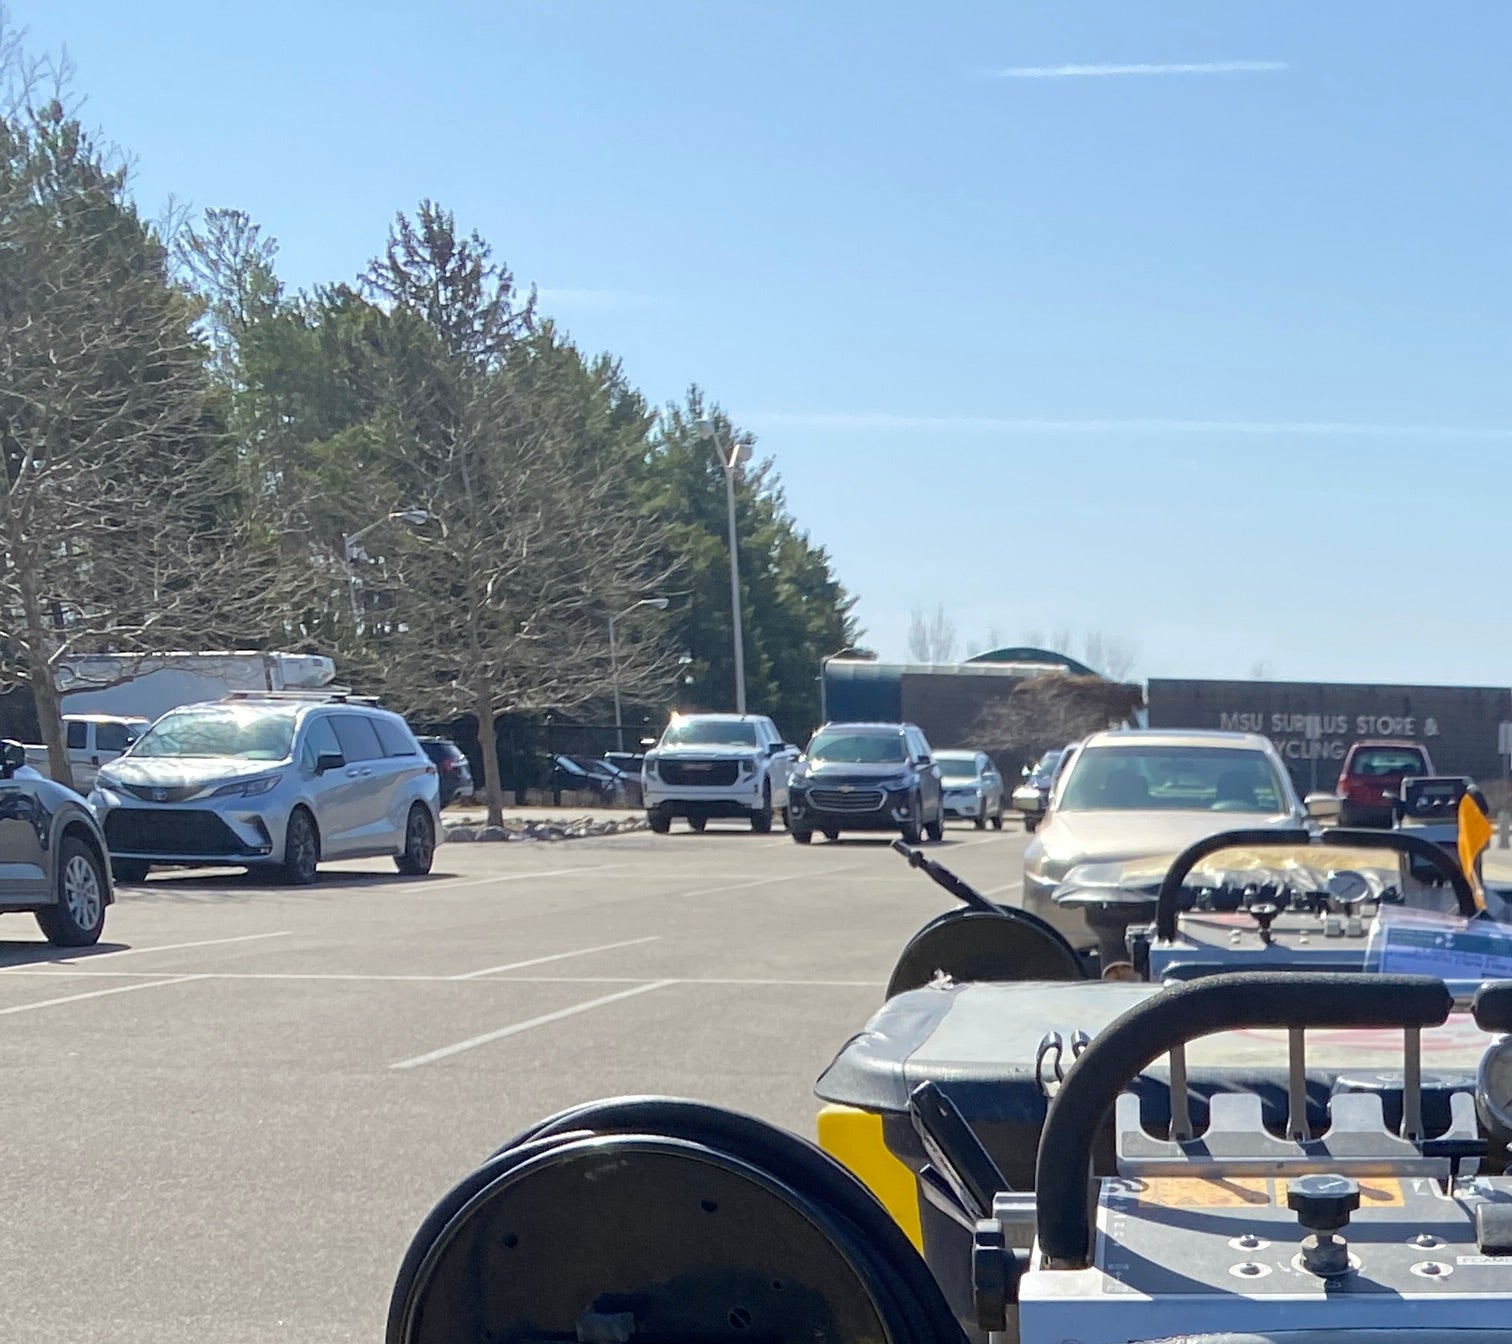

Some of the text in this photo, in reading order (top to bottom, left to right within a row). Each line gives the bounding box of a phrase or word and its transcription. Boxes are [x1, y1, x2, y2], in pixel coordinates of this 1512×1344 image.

[1219, 713, 1440, 736] MSU SURUS STORE &
